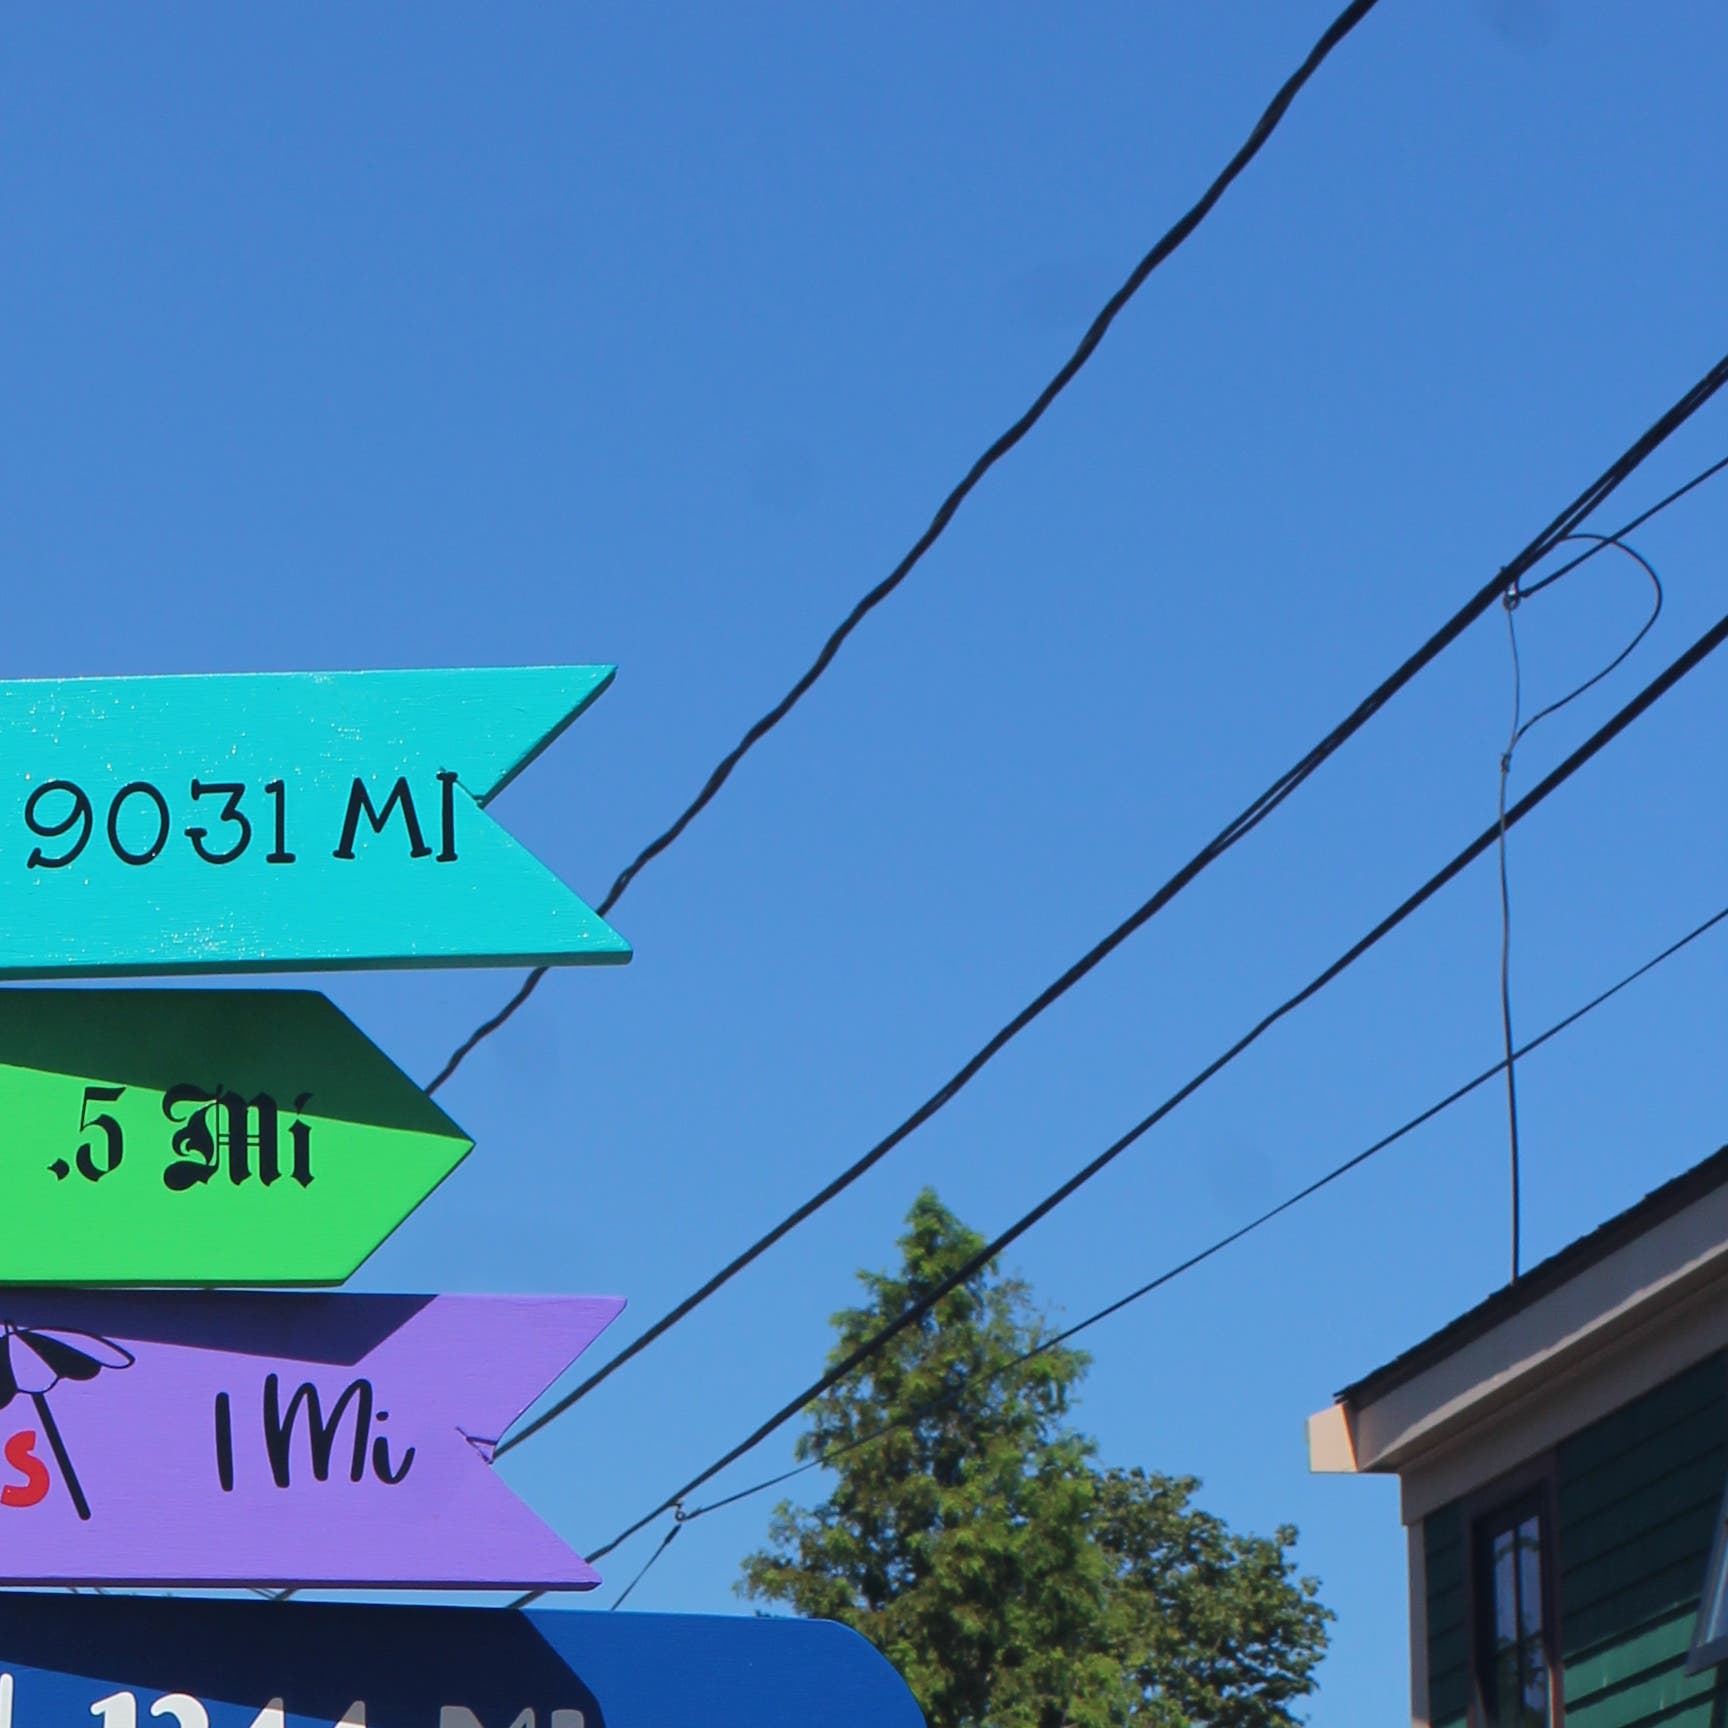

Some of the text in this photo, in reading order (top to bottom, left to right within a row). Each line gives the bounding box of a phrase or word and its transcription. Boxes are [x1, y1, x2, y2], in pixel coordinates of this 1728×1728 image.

[24, 779, 297, 871] 9031
[332, 770, 459, 865] MI
[47, 1086, 125, 1183] .5
[162, 1083, 316, 1191] Mi
